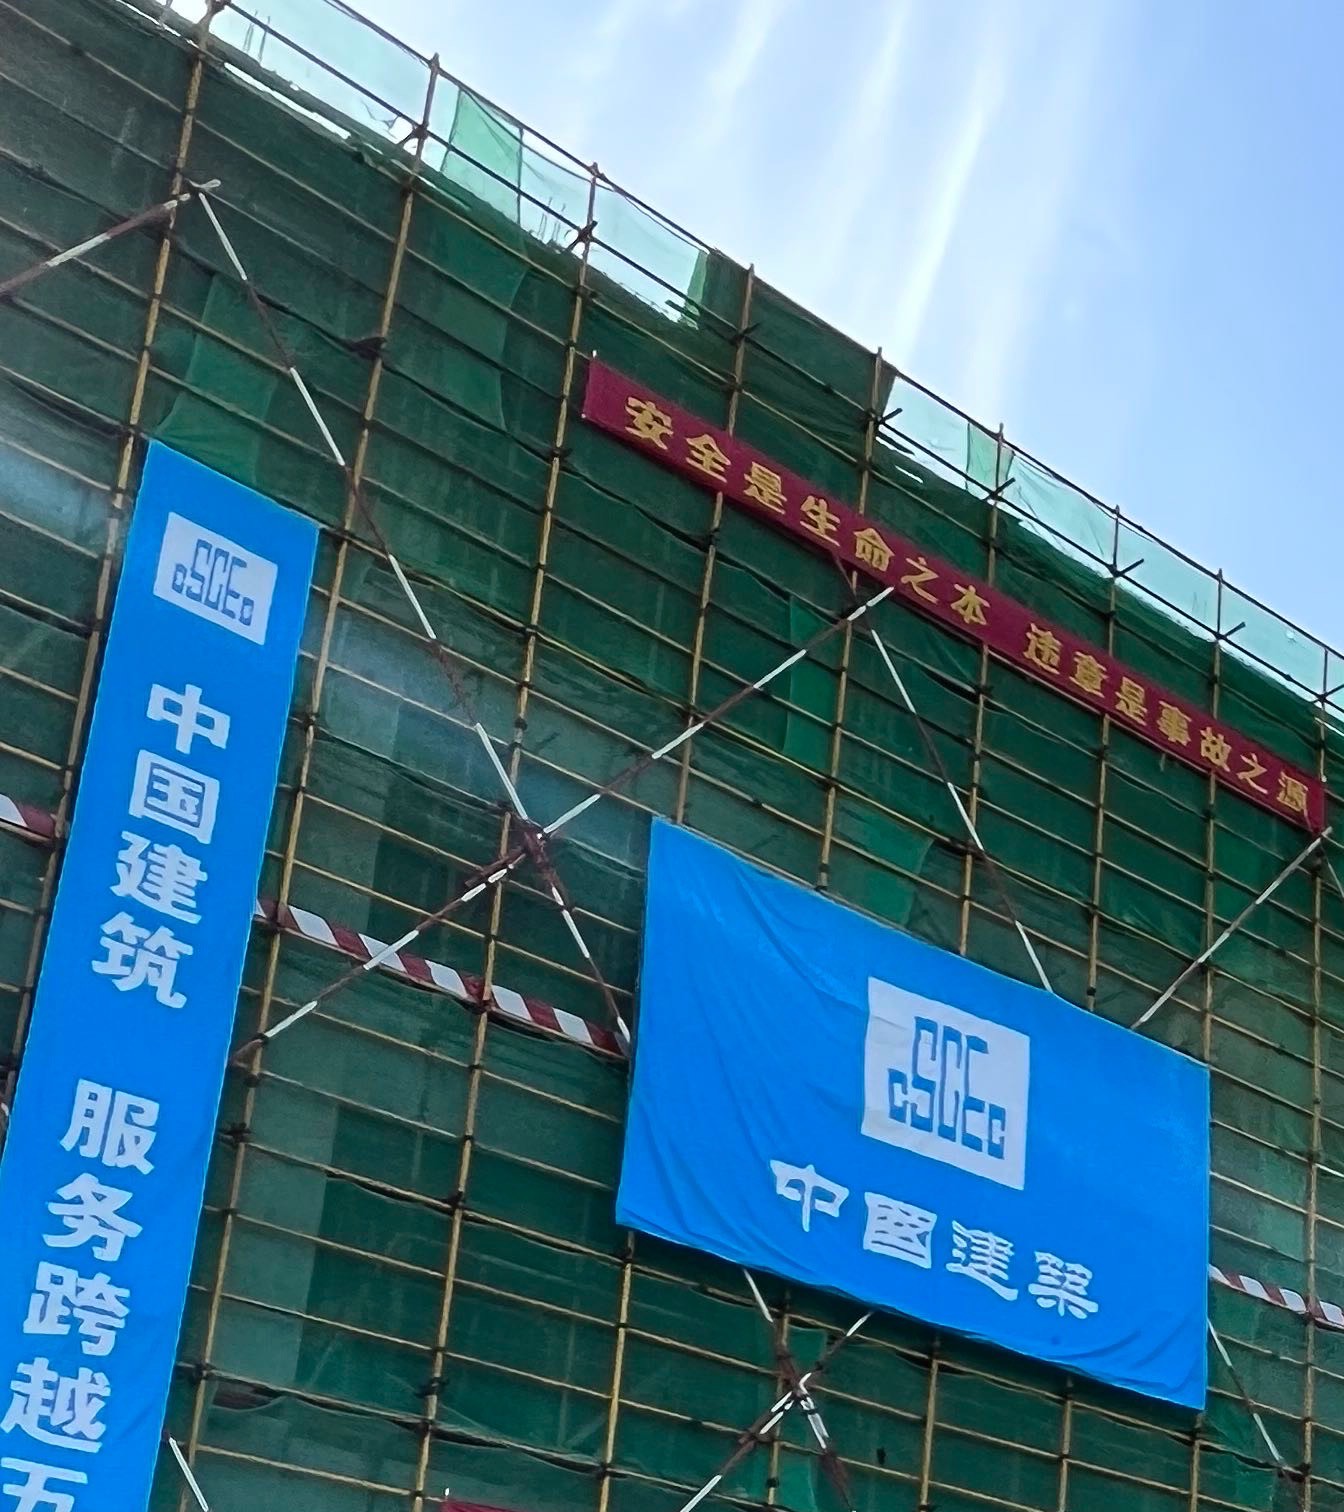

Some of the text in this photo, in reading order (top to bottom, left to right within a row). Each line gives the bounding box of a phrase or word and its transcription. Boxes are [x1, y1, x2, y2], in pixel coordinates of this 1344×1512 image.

[624, 396, 1312, 816] 安全是生命之本 违章是事故之源
[92, 682, 232, 1010] 中国建筑
